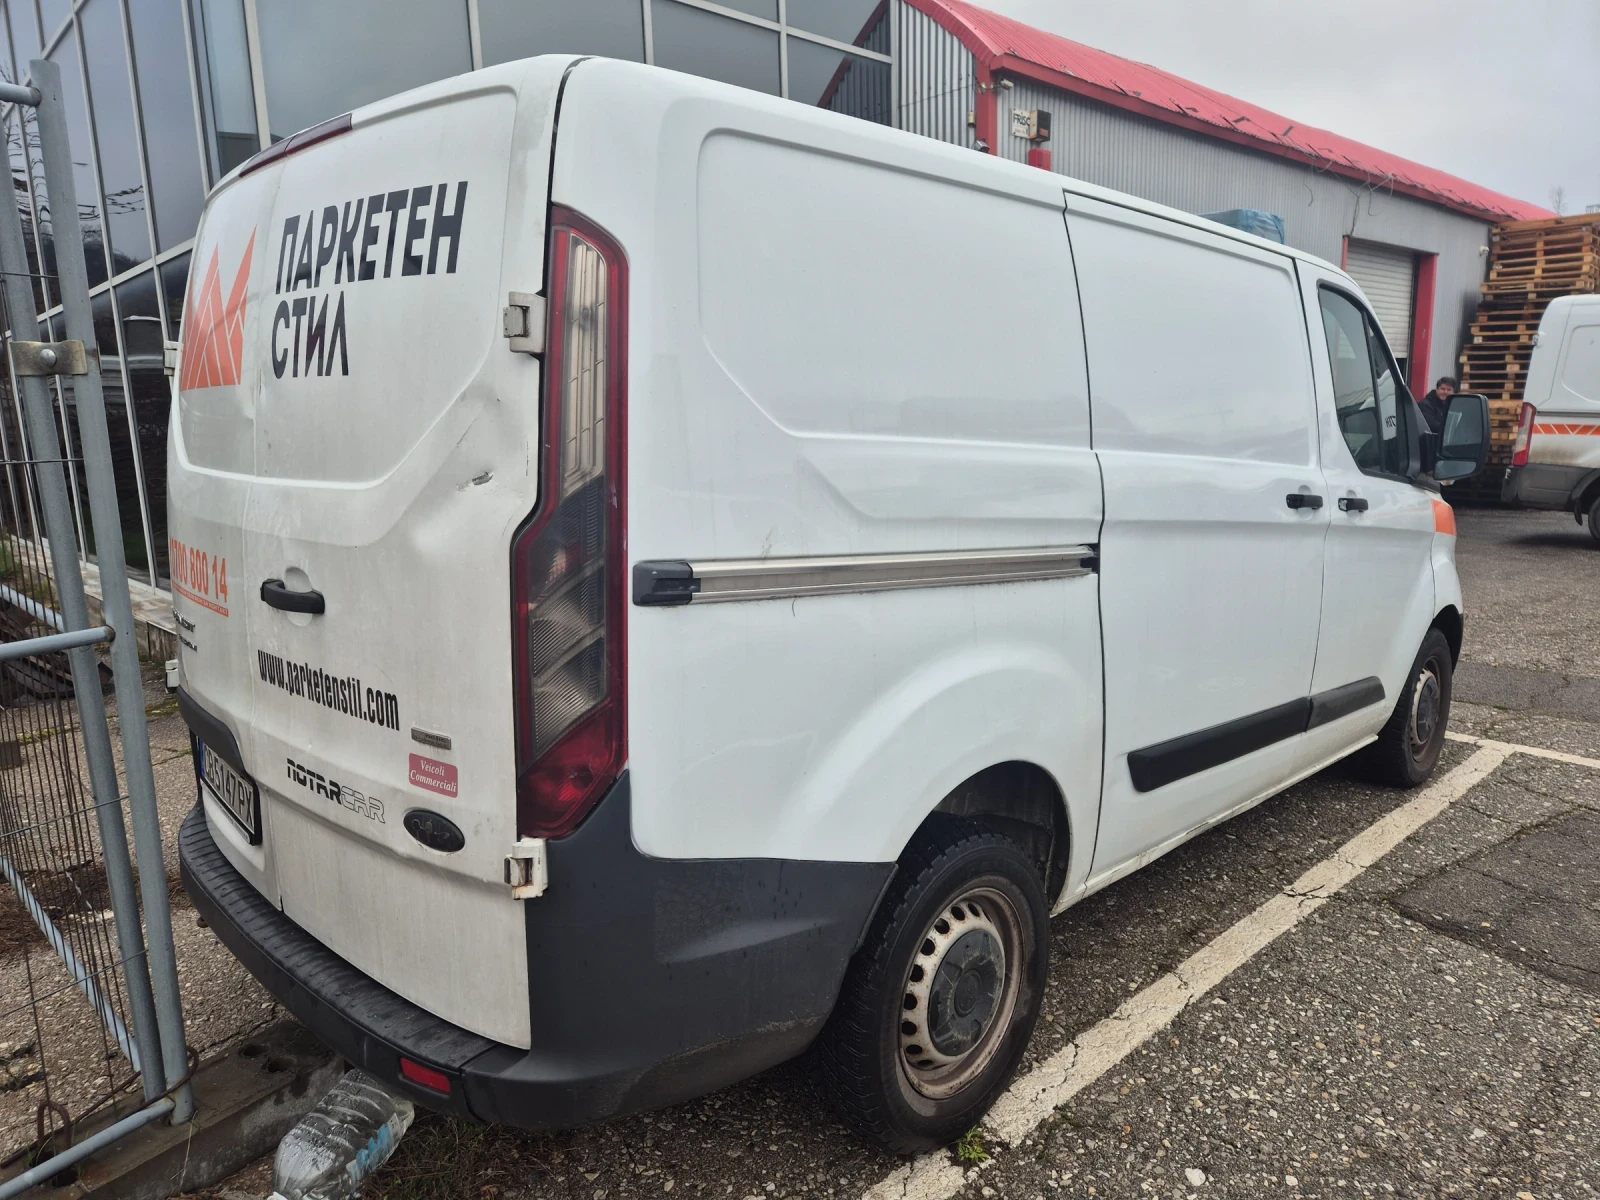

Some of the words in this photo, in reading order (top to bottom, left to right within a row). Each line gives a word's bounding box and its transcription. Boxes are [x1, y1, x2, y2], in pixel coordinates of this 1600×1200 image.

[275, 181, 468, 295] ПАРКЕТЕН
[272, 291, 349, 379] СТИЛ
[190, 547, 208, 595] 800
[212, 555, 228, 603] 14
[258, 650, 399, 731] www.parketenstil.com
[410, 770, 457, 793] Commerciali
[420, 759, 445, 776] Veicoli
